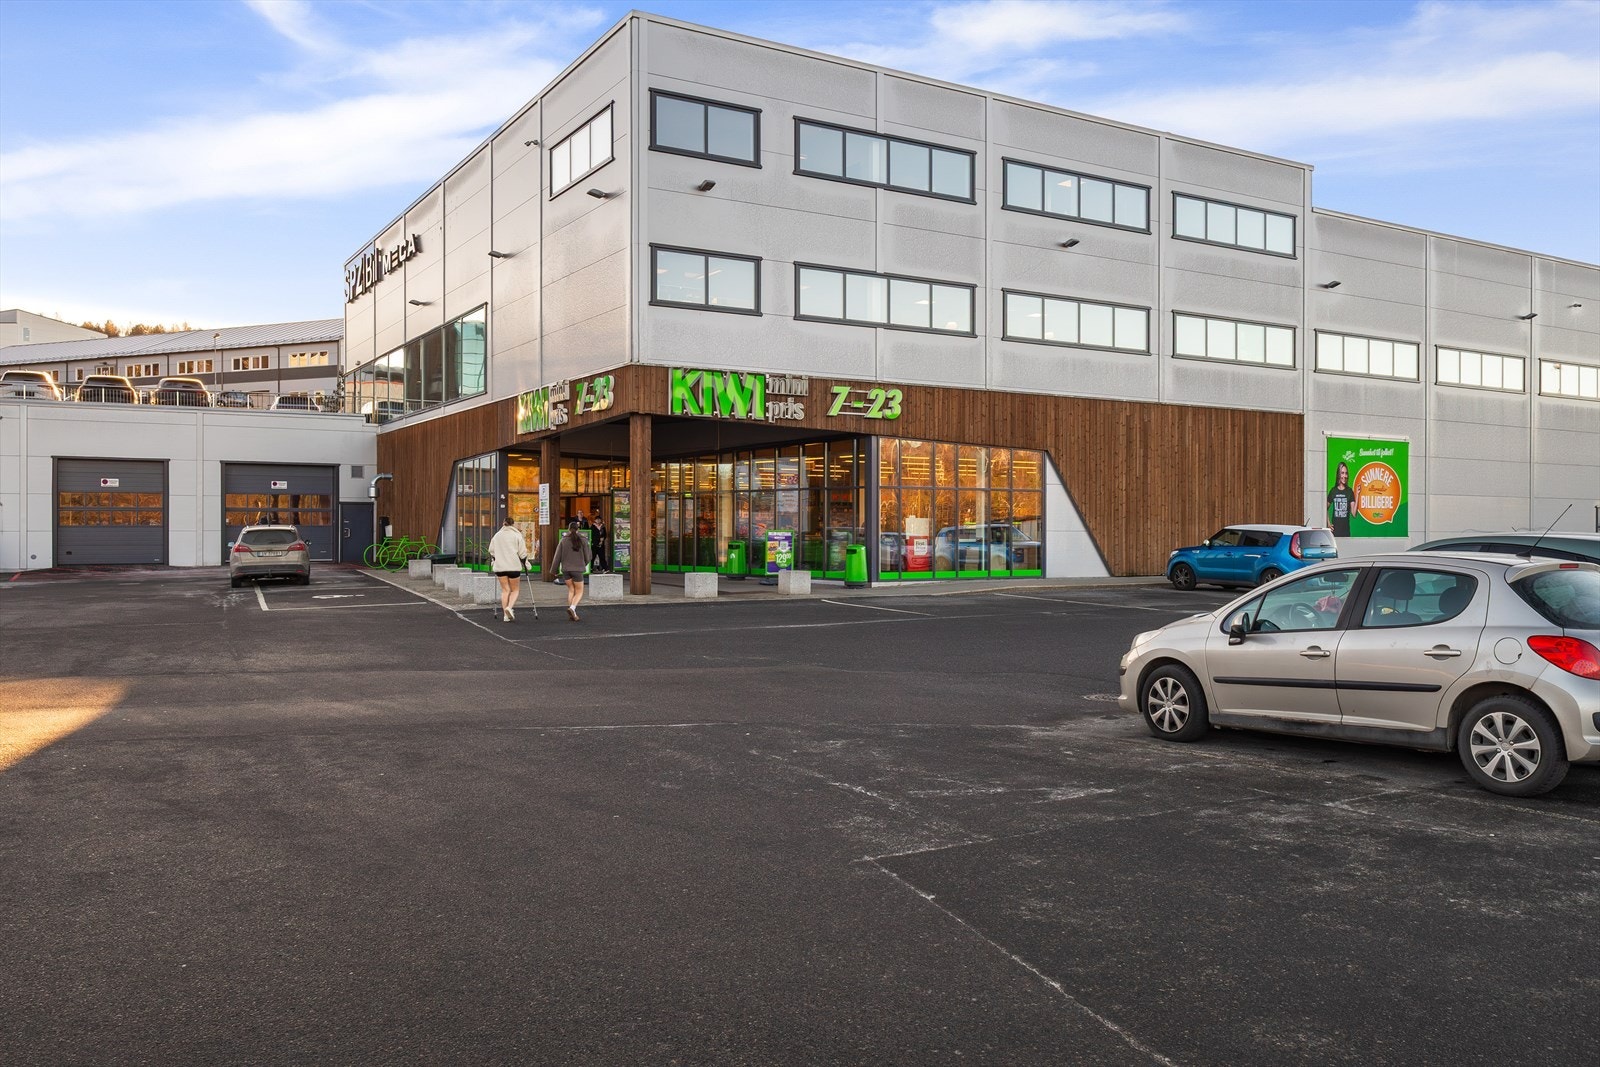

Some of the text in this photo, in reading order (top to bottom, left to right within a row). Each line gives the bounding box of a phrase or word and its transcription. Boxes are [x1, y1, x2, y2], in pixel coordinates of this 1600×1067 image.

[575, 375, 614, 415] 7-23
[669, 367, 765, 420] KIWI
[768, 374, 809, 396] mini
[517, 386, 550, 434] KIWI
[768, 397, 805, 423] pris
[826, 385, 903, 420] 7-23
[1361, 468, 1394, 487] SUNNERE
[1361, 496, 1393, 509] BILLIGERE
